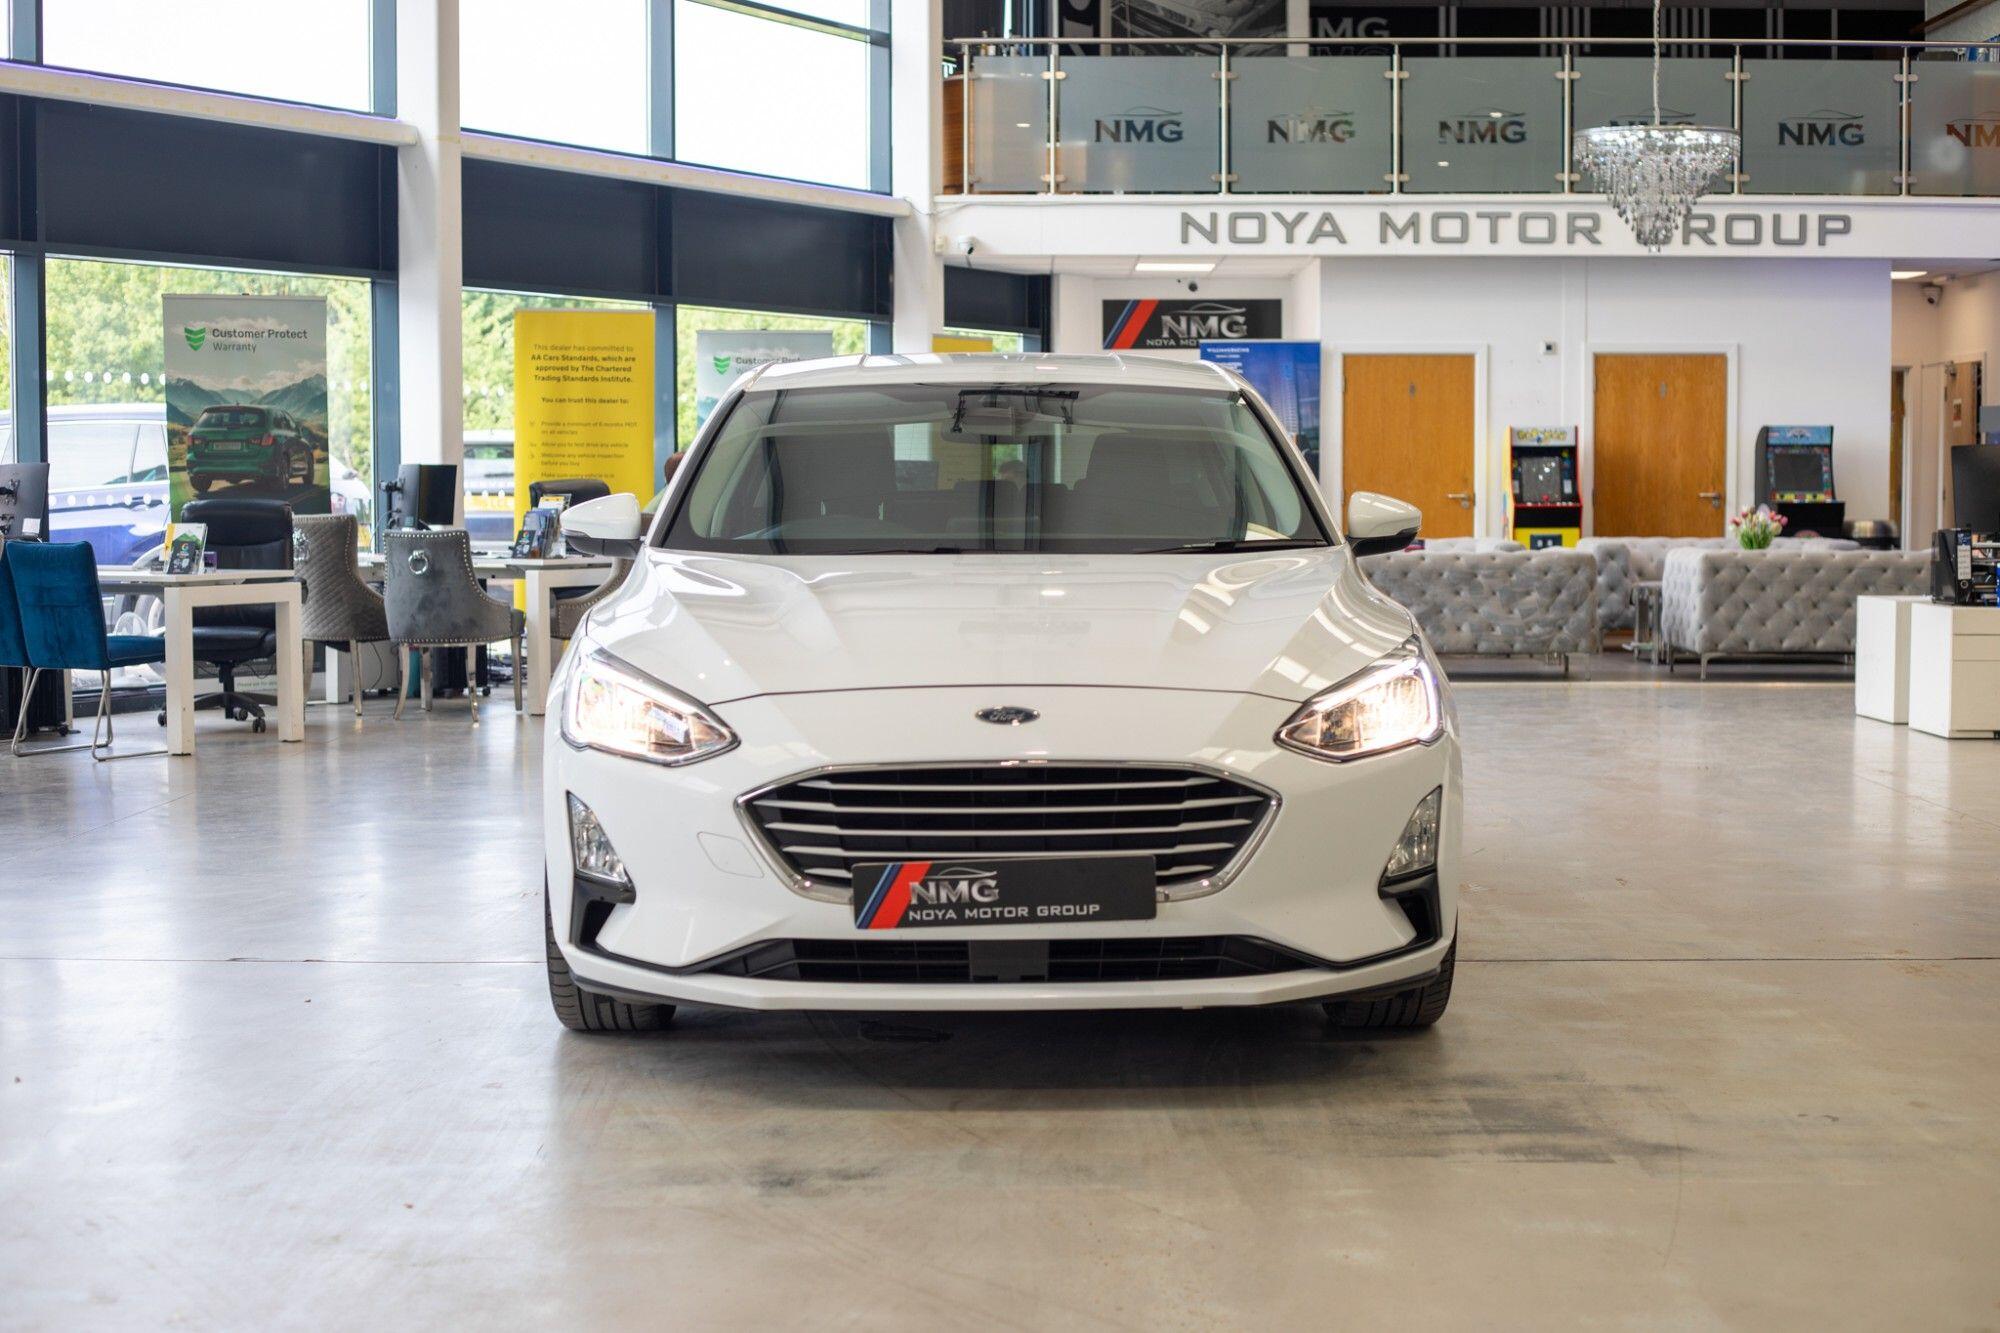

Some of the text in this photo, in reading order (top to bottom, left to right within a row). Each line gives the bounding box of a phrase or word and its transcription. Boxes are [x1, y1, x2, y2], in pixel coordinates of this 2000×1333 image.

[1094, 119, 1184, 143] NMG
[1267, 119, 1356, 144] NMG
[1438, 120, 1527, 144] NMG
[1777, 121, 1865, 146] NMG
[1180, 211, 1347, 245] NOYA
[1378, 211, 1602, 245] MOTOR
[211, 328, 308, 340] Customer Protect
[1160, 314, 1248, 339] NMG
[212, 342, 257, 353] Warranty
[533, 344, 634, 352] This dealer has committed to
[1146, 338, 1176, 347] NOYA
[531, 354, 541, 362] AA
[543, 354, 559, 362] Cars
[602, 354, 622, 362] which
[624, 354, 636, 362] are
[535, 364, 632, 373] approved by The Chartered
[534, 375, 633, 383] Trading Standards Institute.
[908, 878, 1000, 905] NMG
[908, 903, 1101, 921] NOYA MOTOR GROUP
